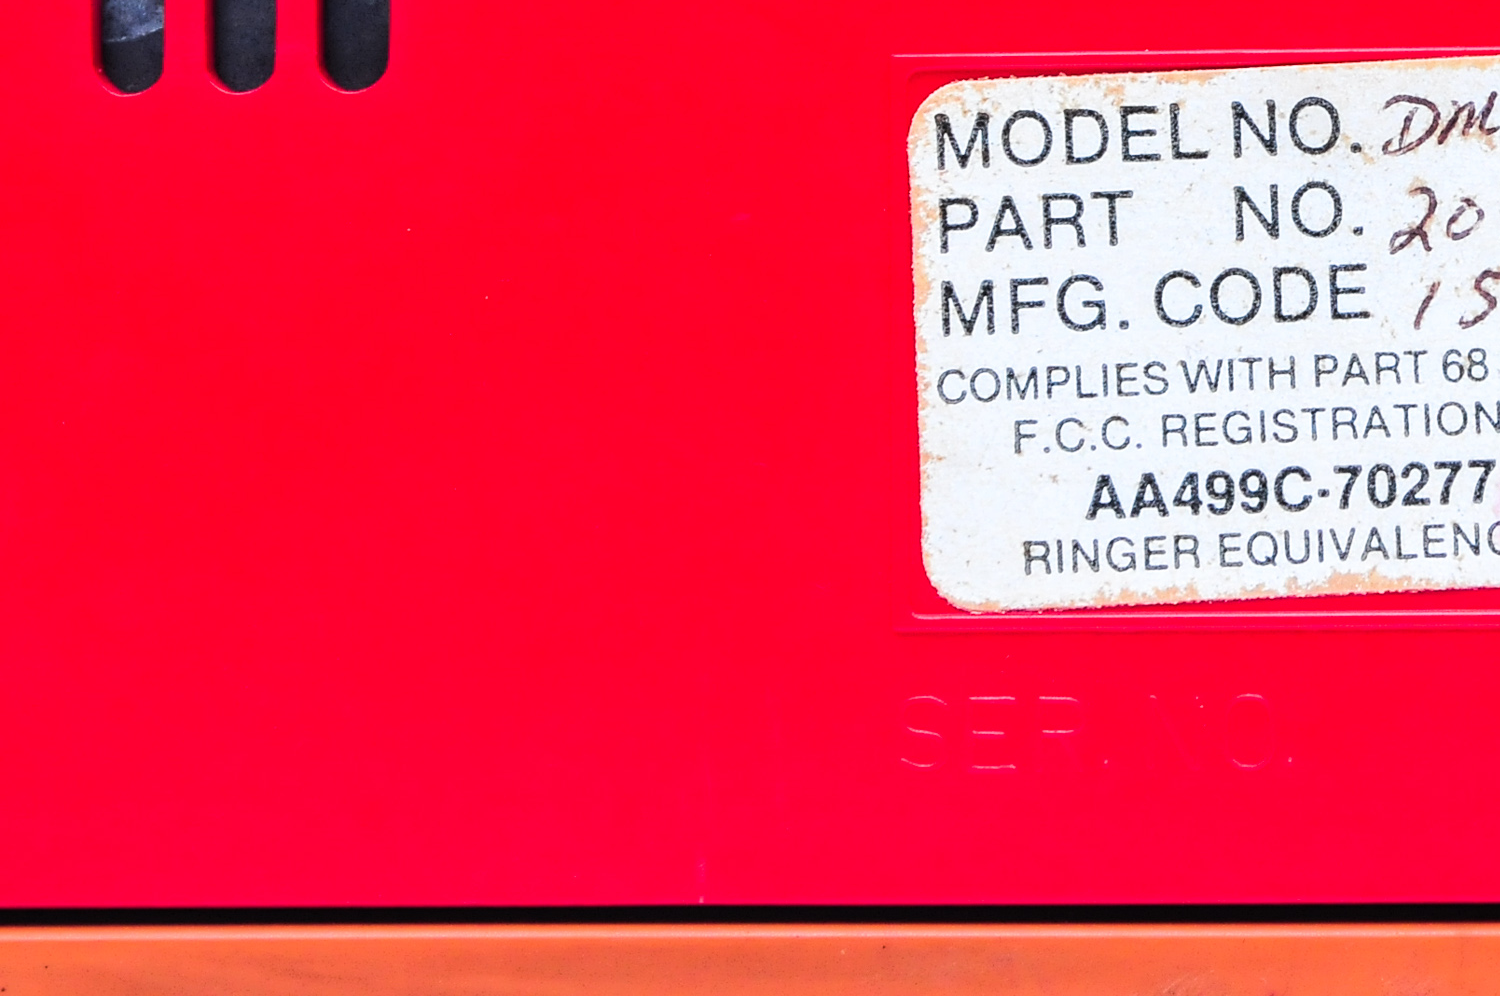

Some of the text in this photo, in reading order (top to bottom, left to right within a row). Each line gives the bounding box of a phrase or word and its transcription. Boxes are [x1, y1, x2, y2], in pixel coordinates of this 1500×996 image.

[934, 95, 1363, 170] MODEL NO.
[939, 180, 1364, 253] PART NO.
[941, 263, 1371, 337] MFG. CODE
[936, 360, 1169, 405] COMPLIES
[1180, 355, 1296, 394] WITH
[1314, 349, 1427, 387] PART
[1441, 347, 1489, 383] 68
[1013, 416, 1143, 454] F.C.C.
[1022, 534, 1200, 575] RINGER
